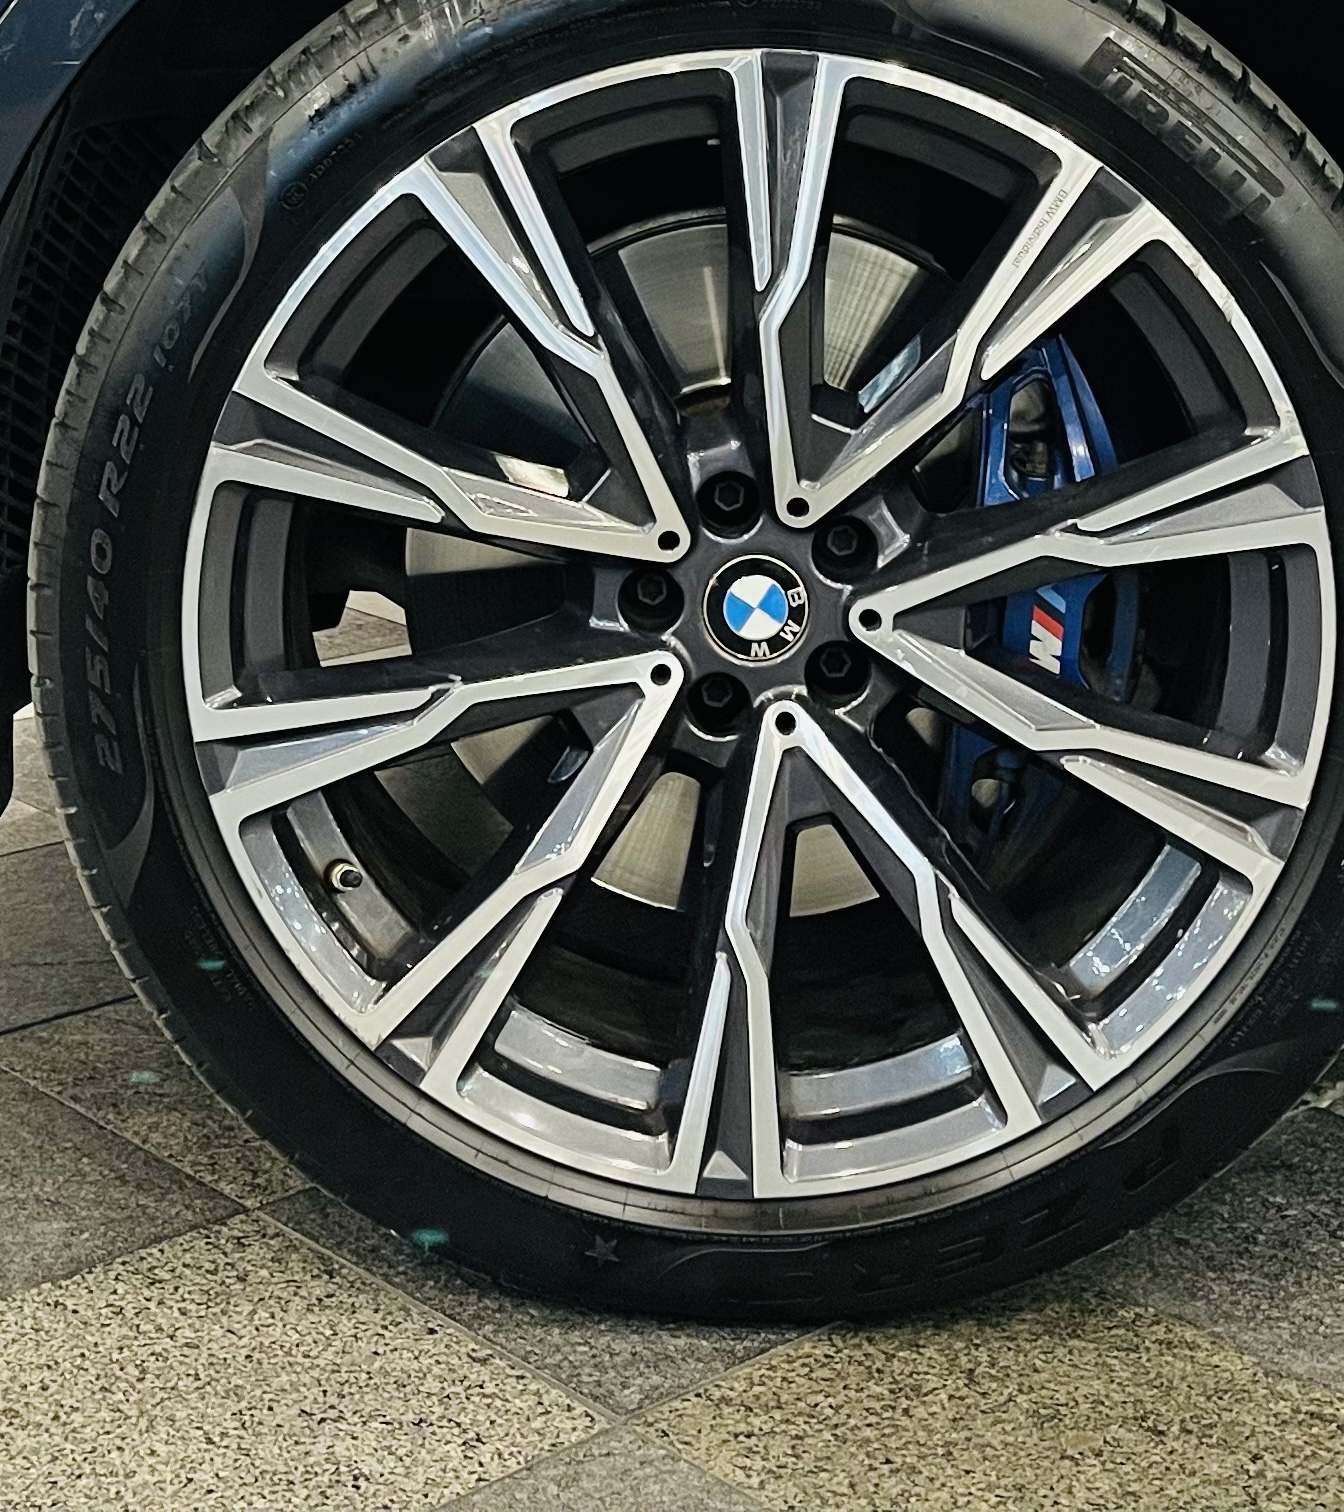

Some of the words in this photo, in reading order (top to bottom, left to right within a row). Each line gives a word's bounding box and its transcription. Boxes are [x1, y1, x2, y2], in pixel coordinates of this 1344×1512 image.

[1081, 37, 1285, 220] PIRELLI
[97, 372, 155, 517] R22
[85, 527, 129, 776] 275/40
